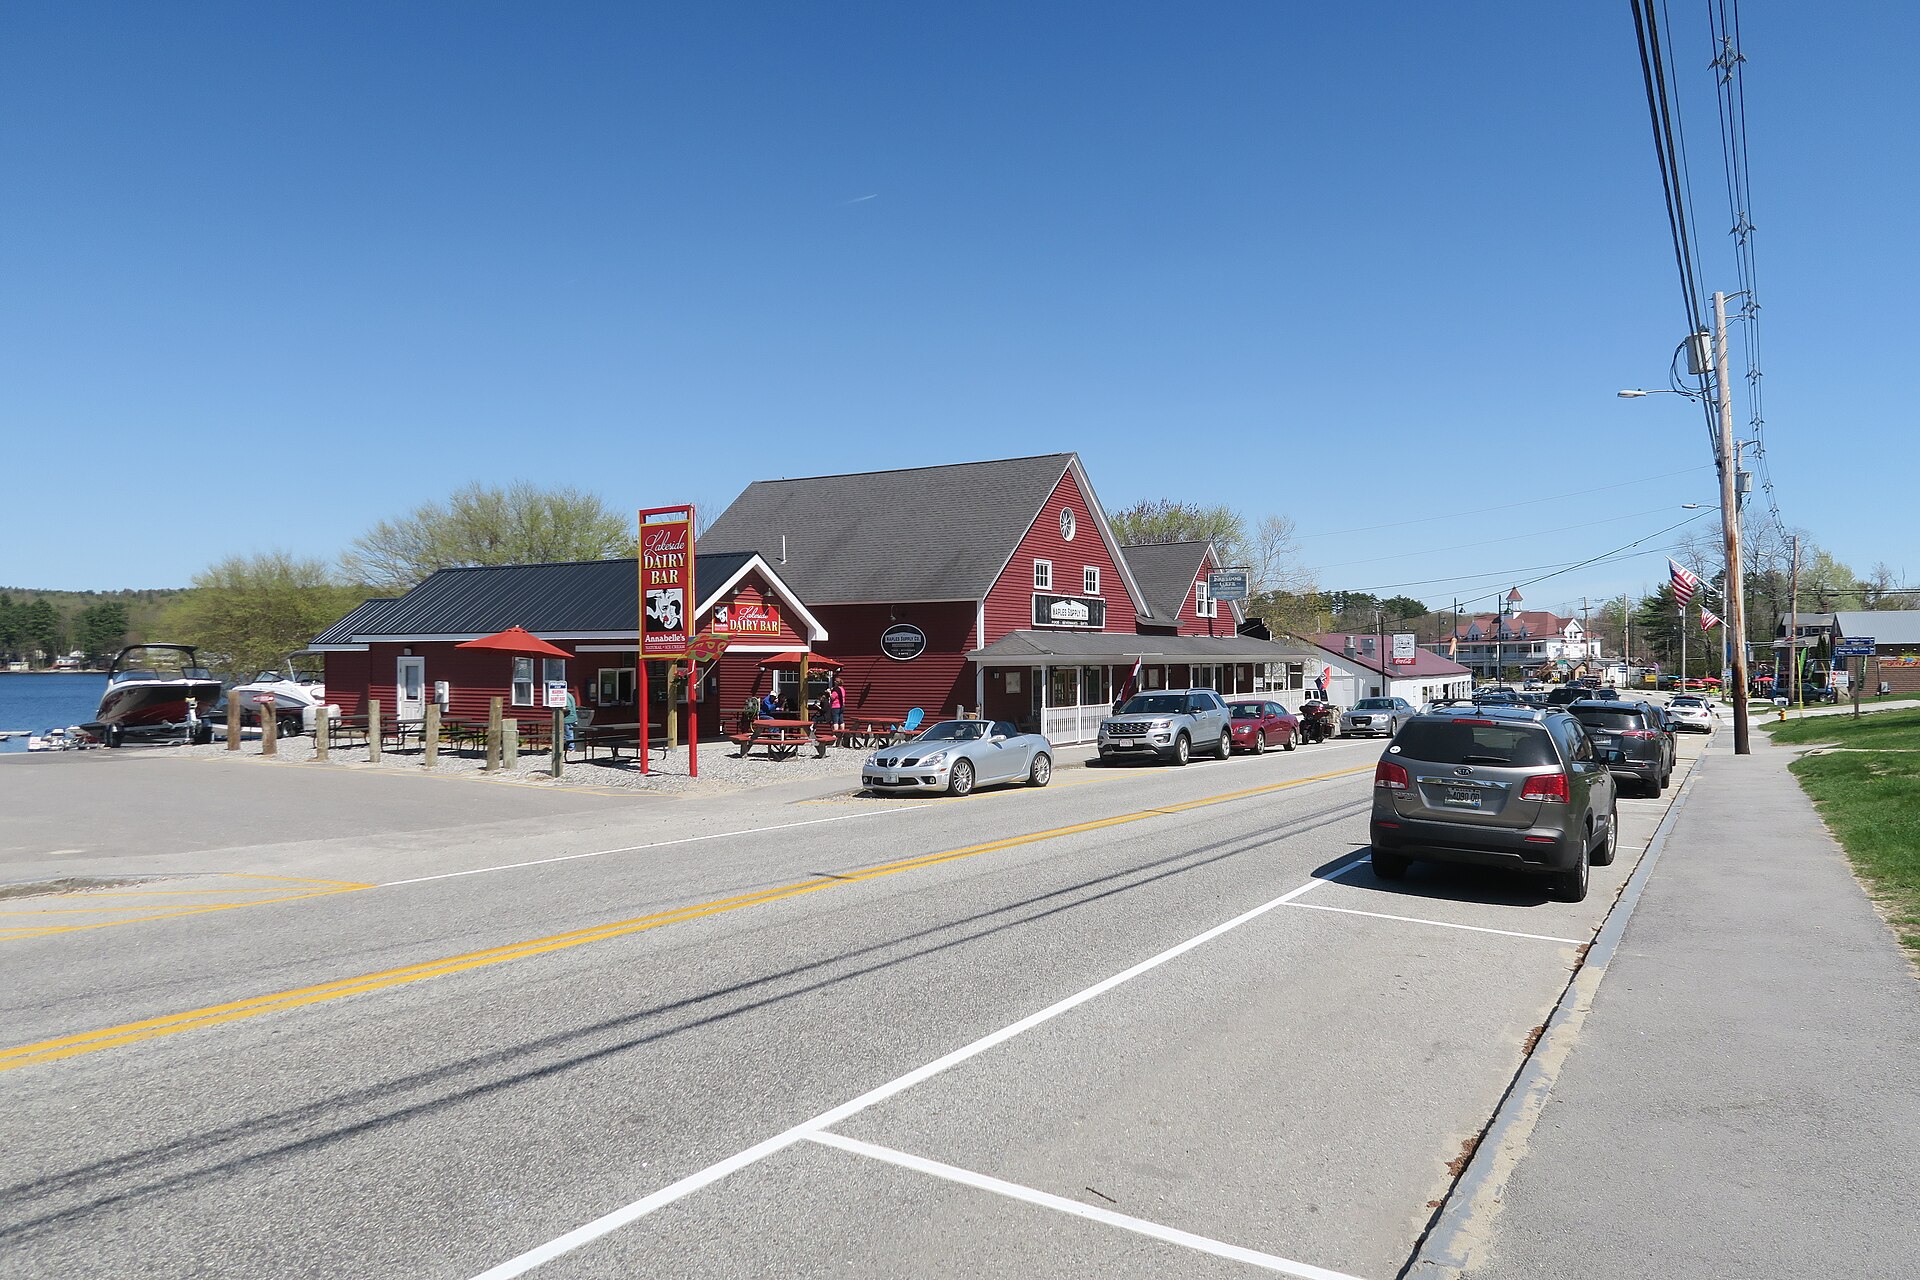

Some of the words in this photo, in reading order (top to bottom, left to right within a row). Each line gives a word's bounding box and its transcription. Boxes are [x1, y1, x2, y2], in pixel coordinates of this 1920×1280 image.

[643, 529, 687, 556] Lakeside
[644, 552, 686, 569] DAIRY
[651, 569, 678, 585] BAR
[1052, 607, 1067, 617] NAPLES
[1067, 607, 1081, 618] SUPPLY
[730, 619, 759, 631] DAIRY
[760, 620, 778, 632] BAR
[645, 633, 686, 643] Annabelle's
